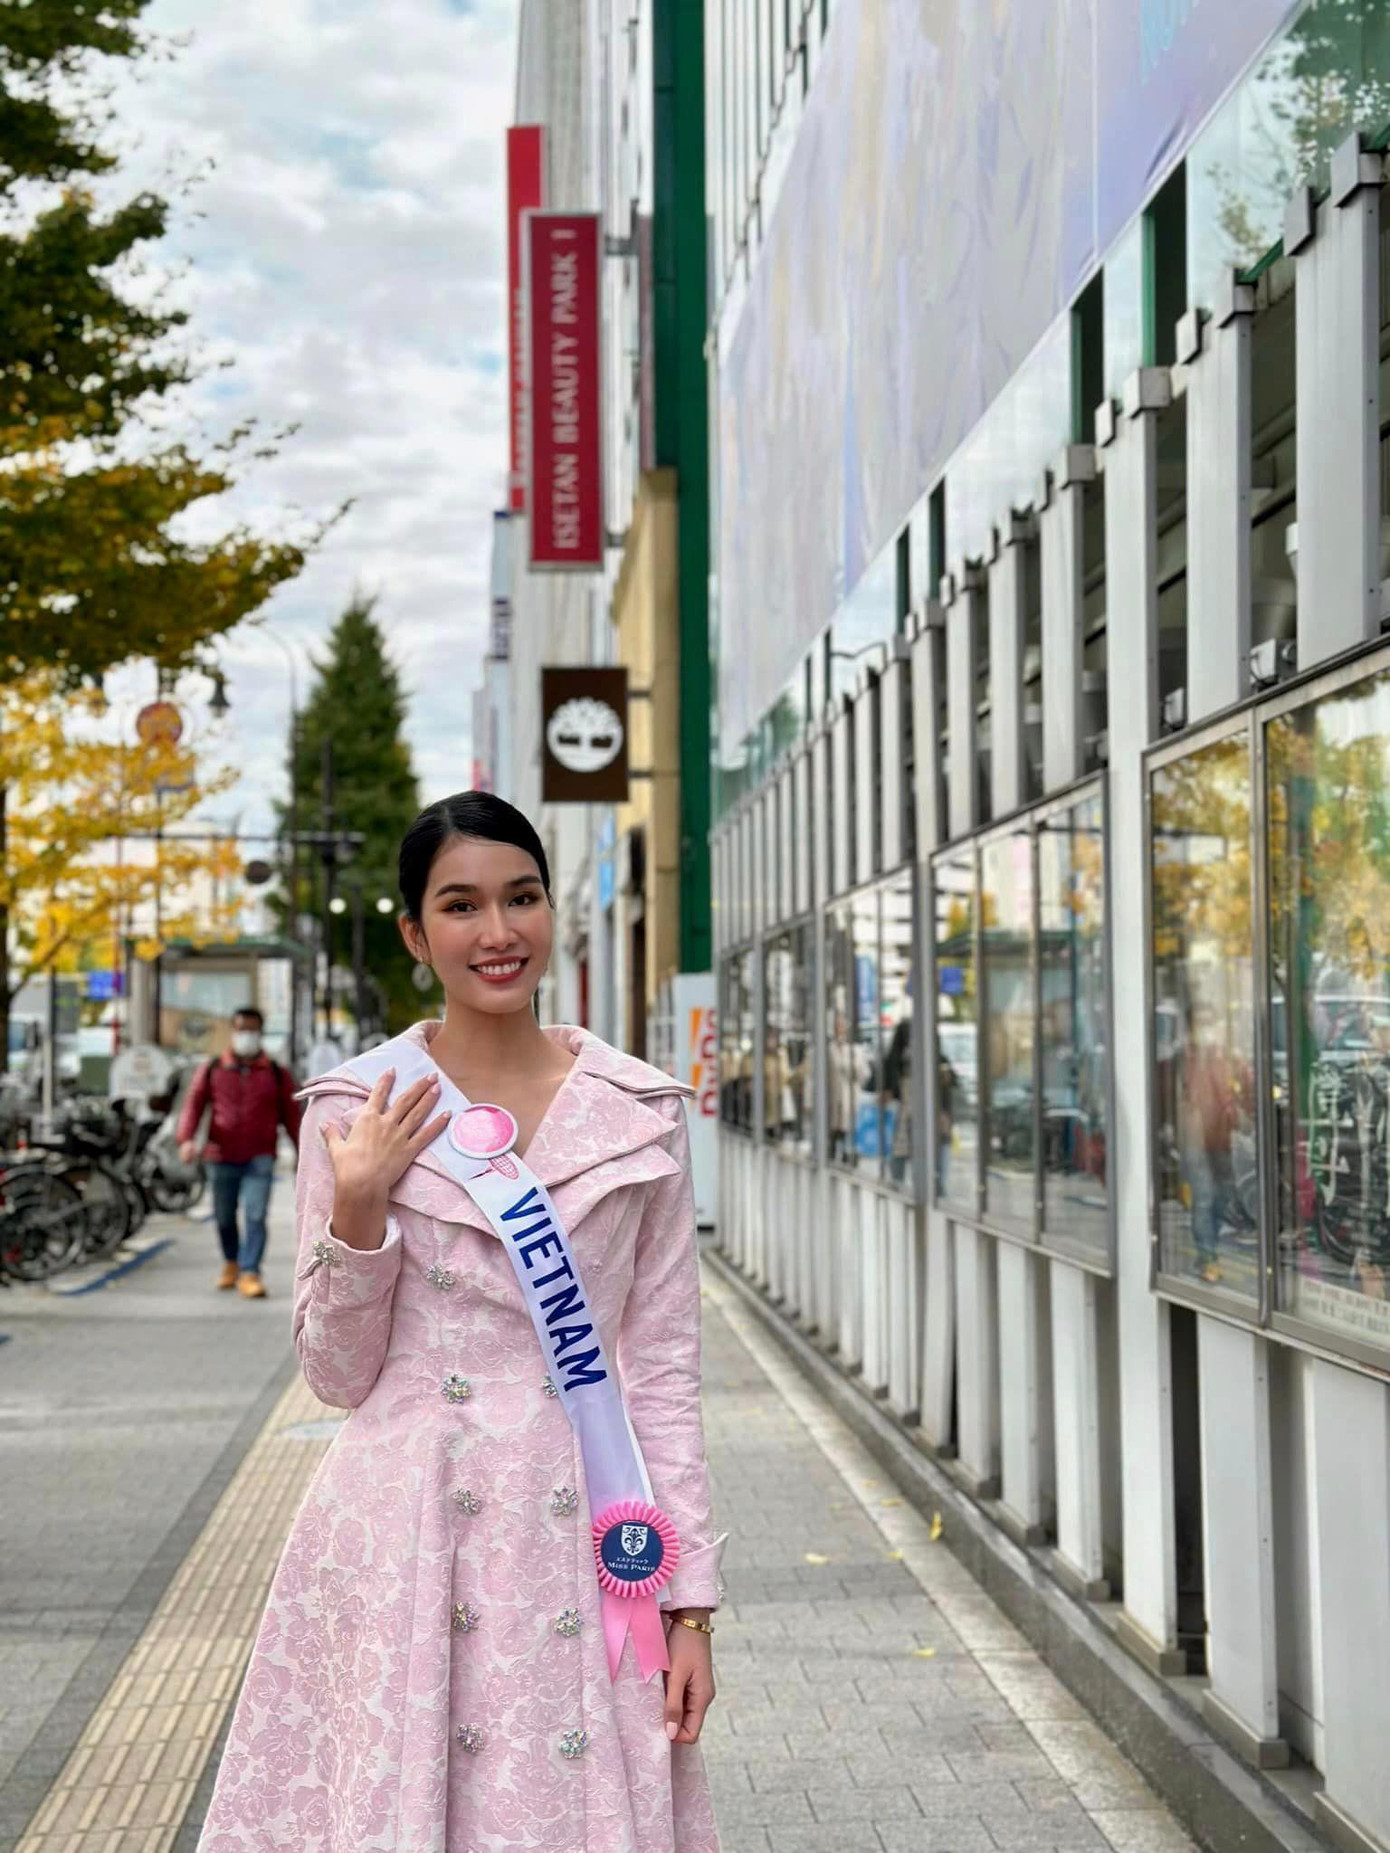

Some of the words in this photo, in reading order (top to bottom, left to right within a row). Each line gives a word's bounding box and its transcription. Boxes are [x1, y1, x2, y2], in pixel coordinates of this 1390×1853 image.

[552, 252, 579, 324] PARK
[552, 332, 580, 443] BEAUTY
[552, 454, 580, 549] ISETAN
[500, 1186, 607, 1392] VIETNAM
